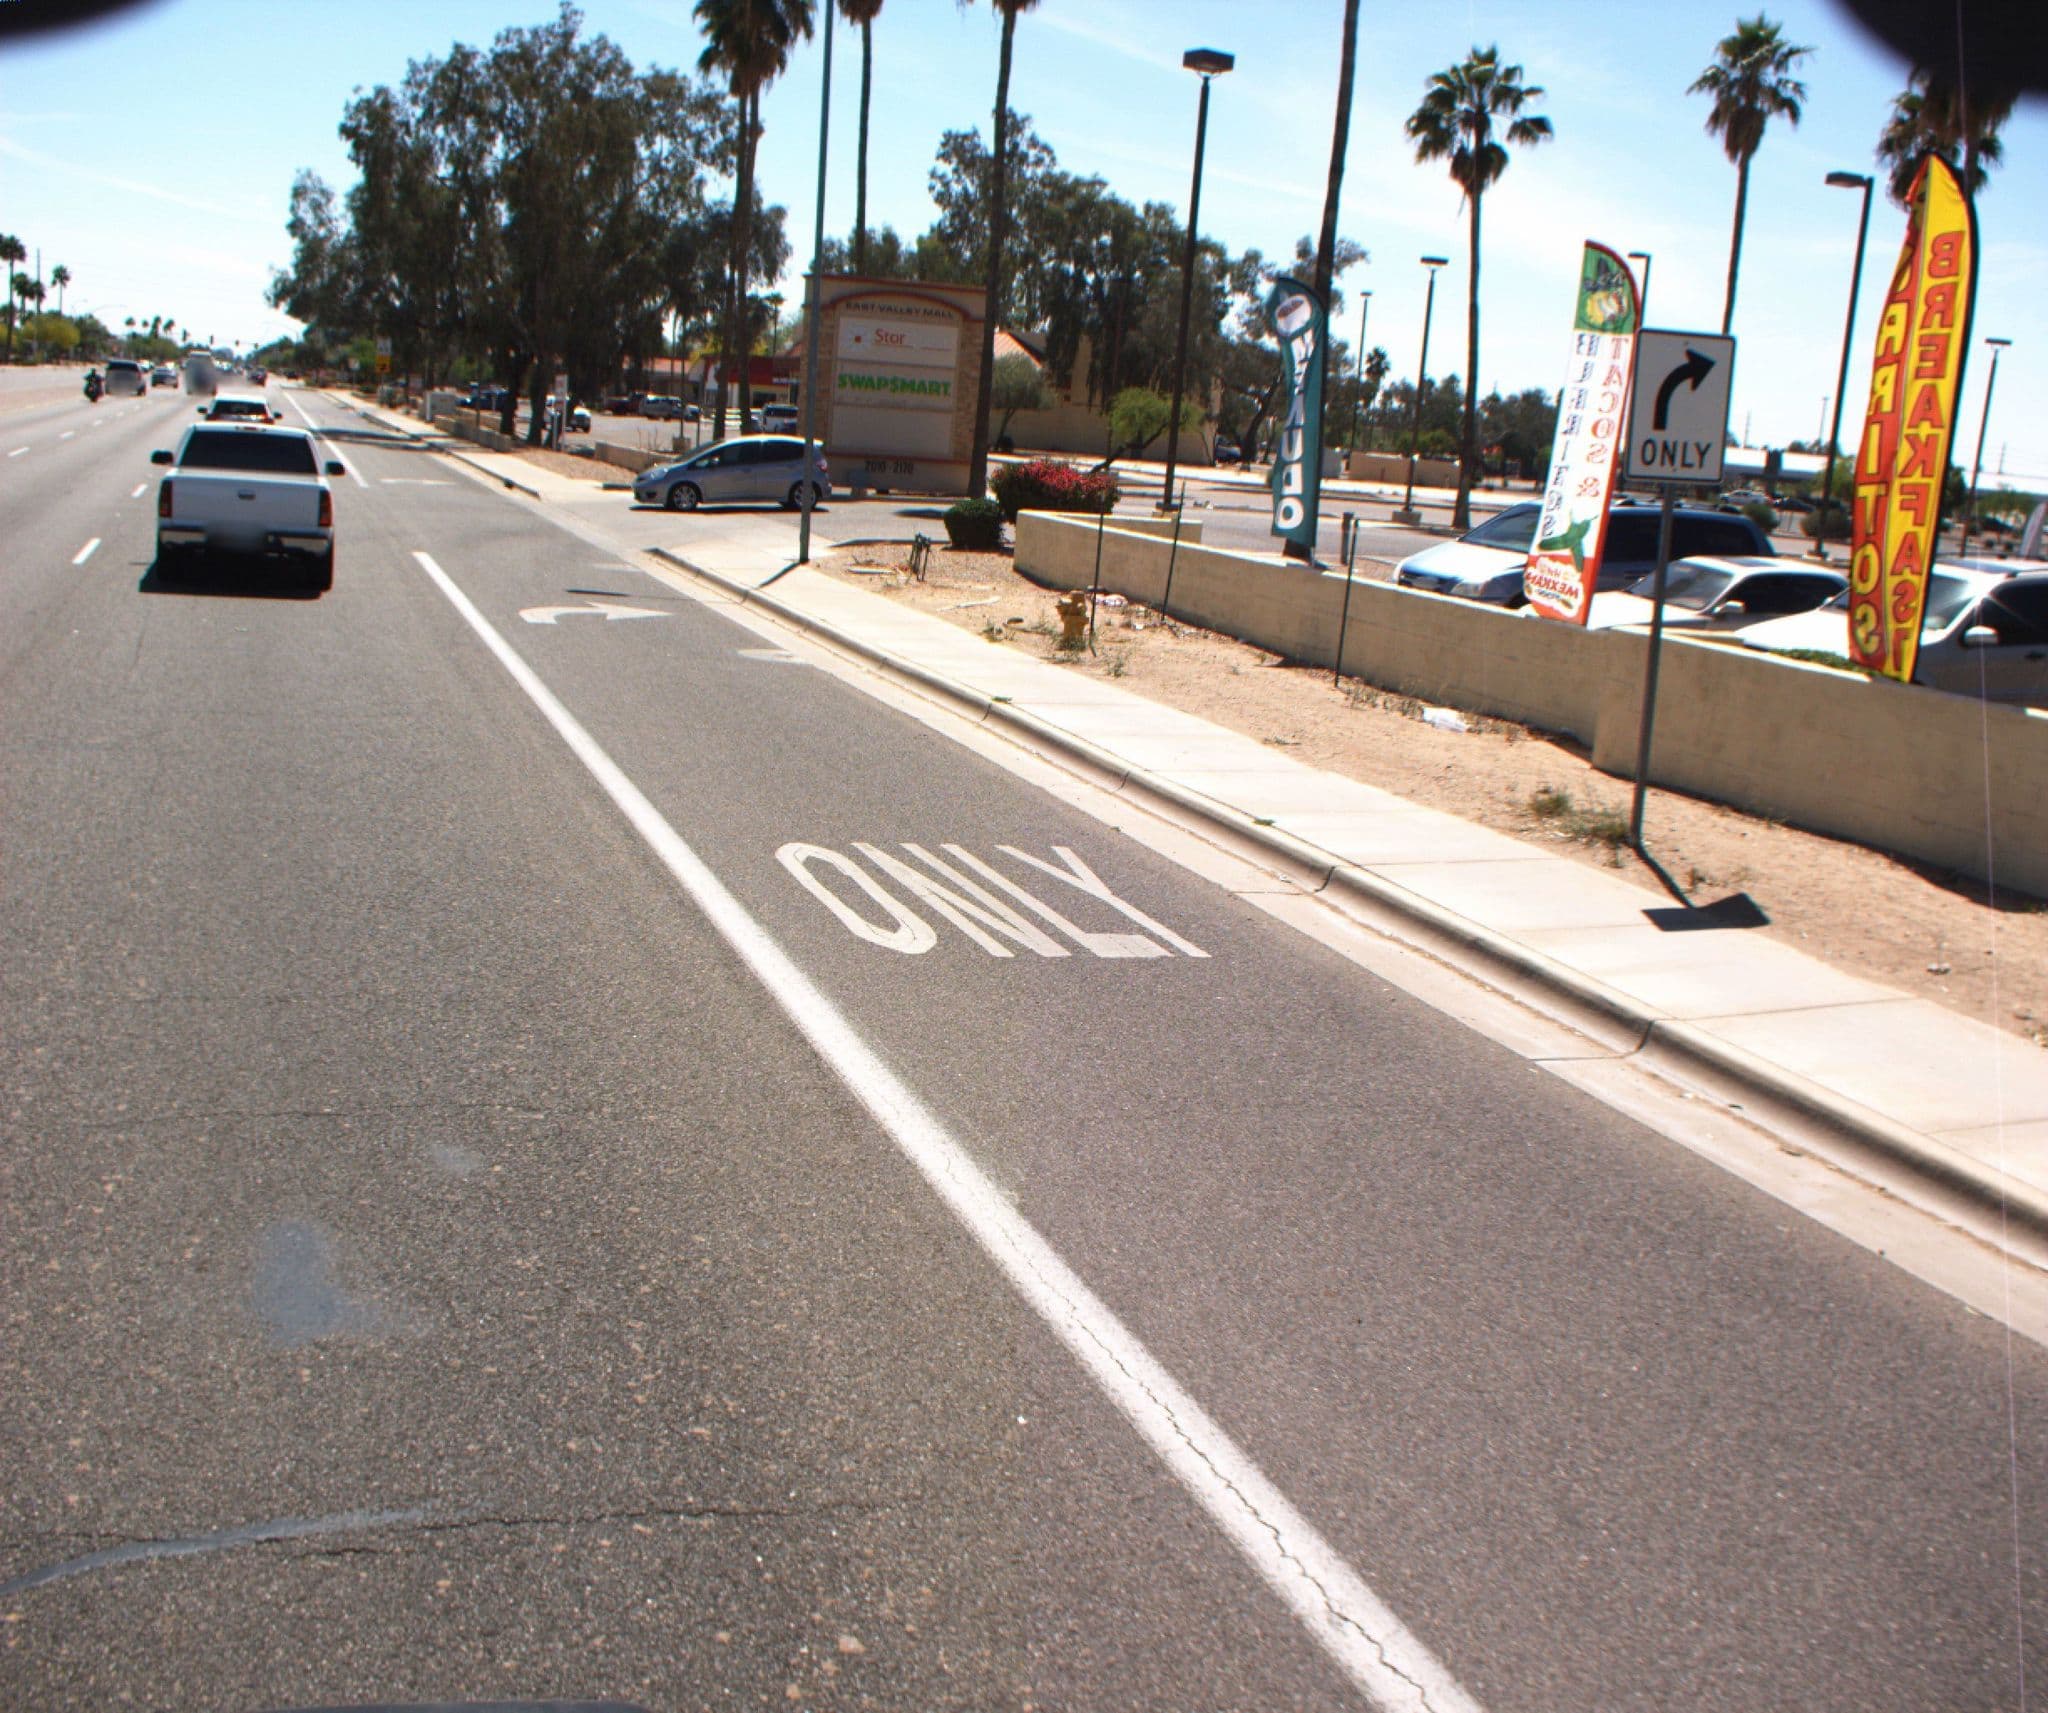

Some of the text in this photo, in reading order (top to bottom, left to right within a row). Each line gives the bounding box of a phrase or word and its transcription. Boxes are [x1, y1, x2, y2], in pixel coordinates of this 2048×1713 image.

[875, 328, 905, 345] Star
[1640, 438, 1713, 469] ONLY
[776, 842, 1212, 957] ONLY
